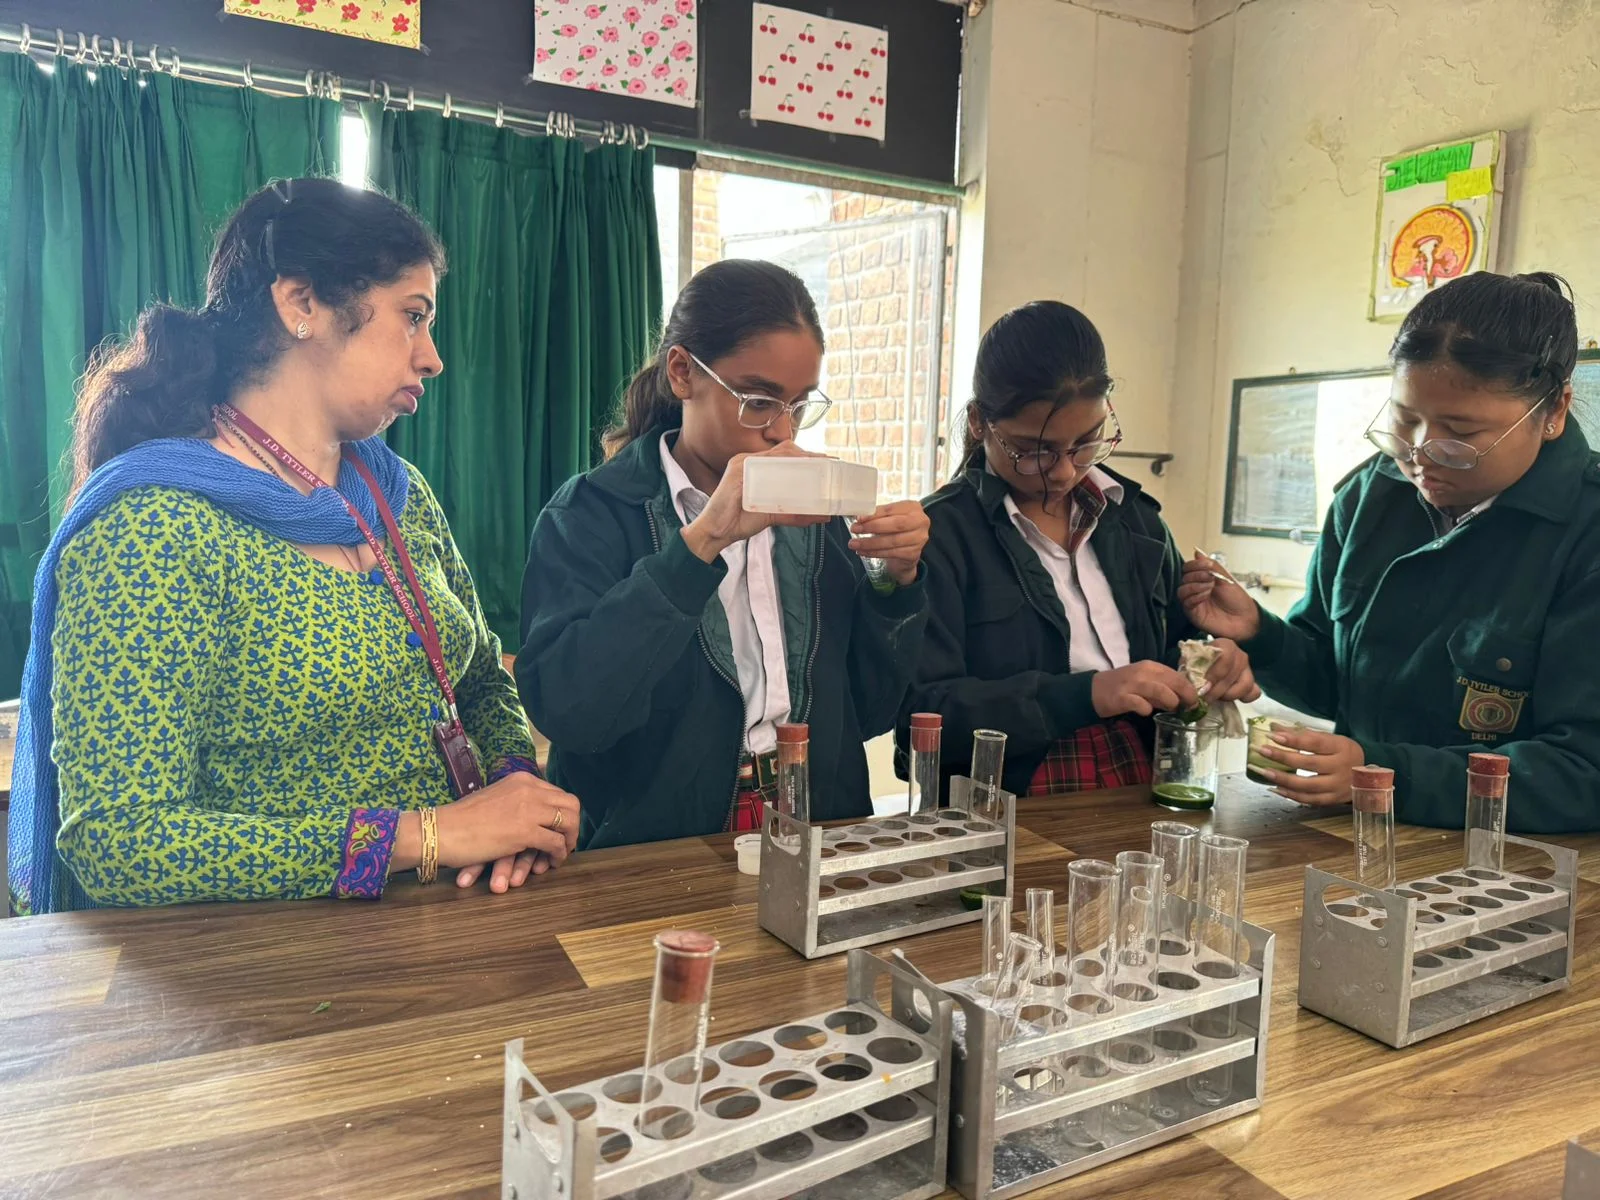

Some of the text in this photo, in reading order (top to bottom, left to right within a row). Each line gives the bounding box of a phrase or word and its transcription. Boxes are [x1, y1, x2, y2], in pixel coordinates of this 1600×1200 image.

[262, 438, 280, 455] J.D.
[281, 452, 316, 483] TYTLER
[376, 545, 397, 583] TYTLER
[393, 583, 416, 621] SCHOOL
[1470, 680, 1501, 693] TYTLER
[1471, 732, 1497, 740] DELHI
